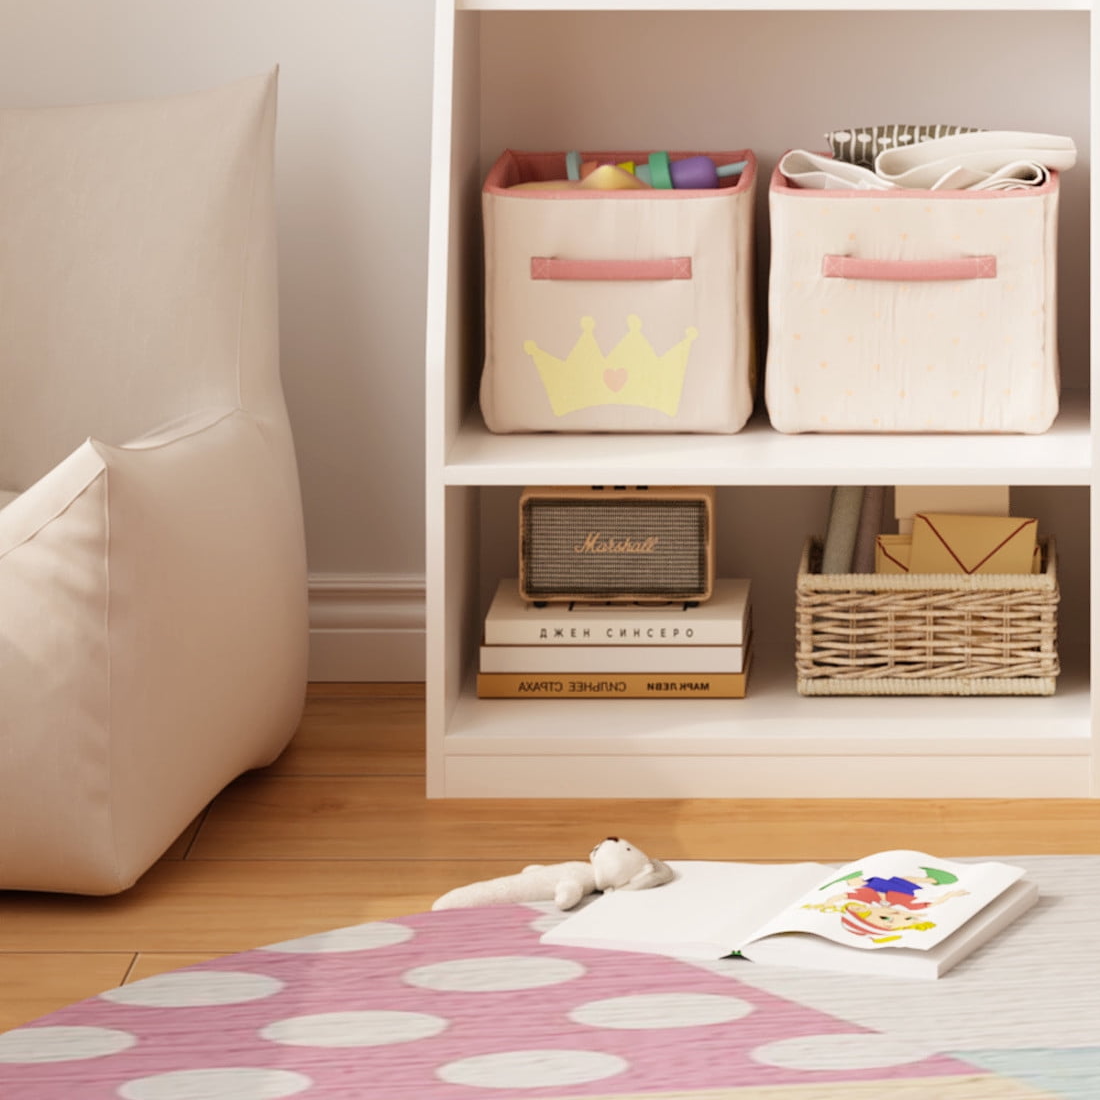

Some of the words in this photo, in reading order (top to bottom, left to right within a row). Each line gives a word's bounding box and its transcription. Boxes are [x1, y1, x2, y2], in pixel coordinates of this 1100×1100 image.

[574, 531, 660, 554] Marshall
[539, 628, 591, 640] ДЖЕН
[606, 628, 695, 639] СИНСЕРО
